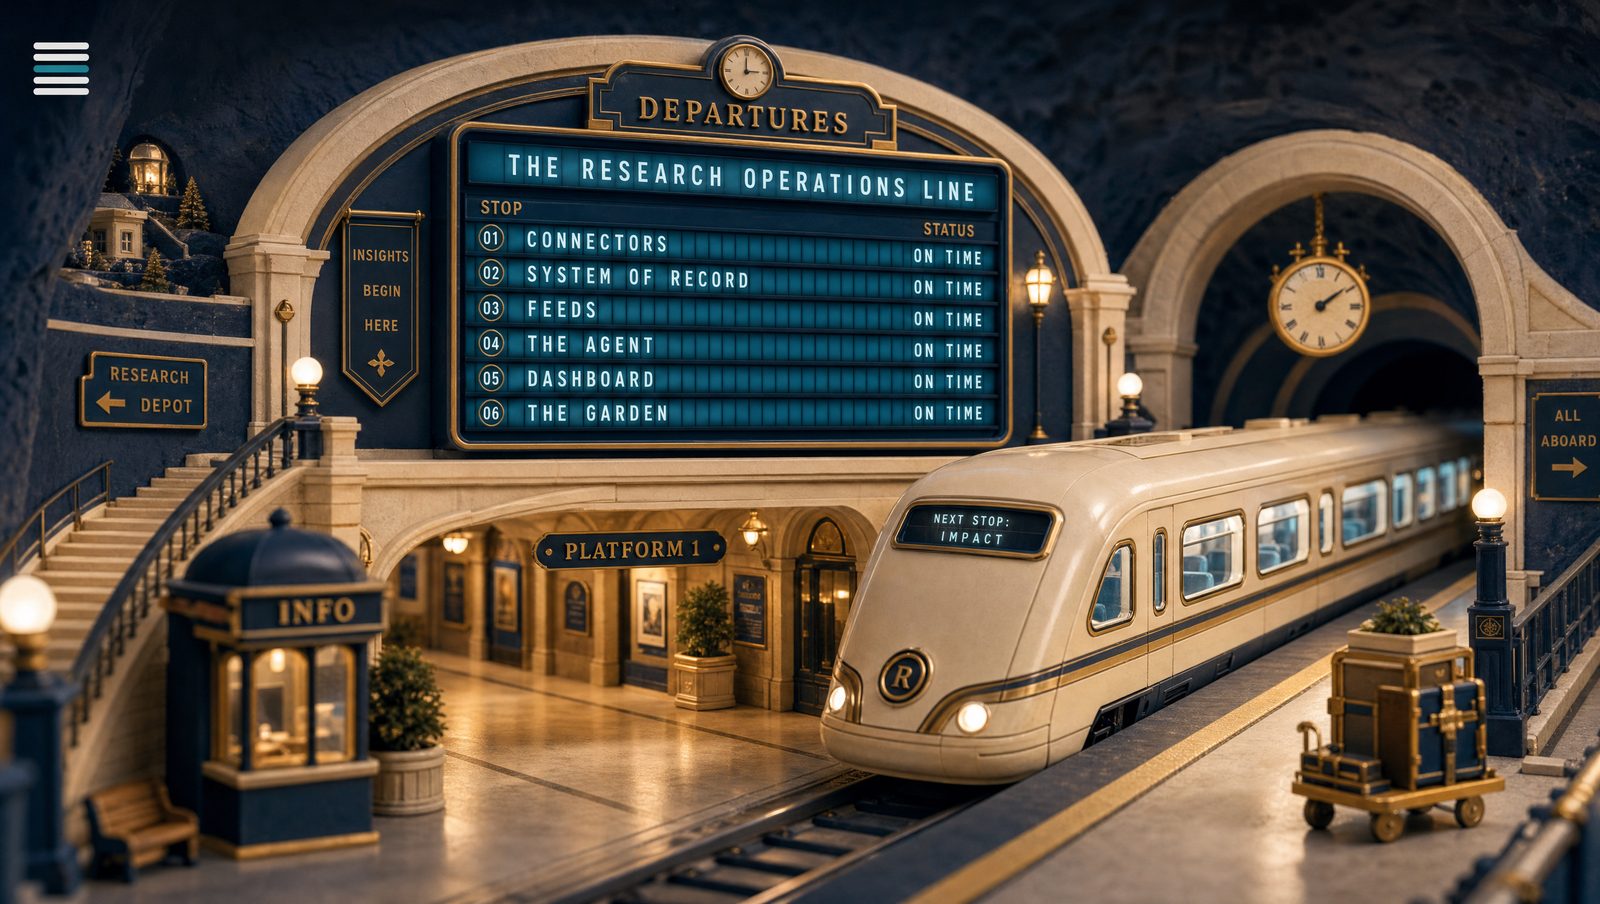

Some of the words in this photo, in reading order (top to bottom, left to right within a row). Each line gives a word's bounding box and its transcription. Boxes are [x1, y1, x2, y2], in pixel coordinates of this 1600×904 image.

[638, 95, 849, 135] DEPARTURES
[508, 153, 558, 179] THE
[582, 158, 722, 188] RESEARCH
[744, 167, 906, 198] OPERATIONS
[924, 179, 974, 202] LINE
[480, 200, 522, 214] STOP
[924, 222, 975, 238] STATUS
[353, 248, 409, 262] INSIGHTS
[483, 230, 499, 245] 01
[527, 230, 667, 252] CONNECTORS
[914, 248, 934, 264] ON
[946, 250, 982, 266] TIME
[483, 266, 500, 280] 02
[527, 265, 611, 284] SYSTEM
[629, 268, 652, 285] OF
[671, 269, 748, 288] RECORD
[914, 280, 934, 295] ON
[946, 280, 982, 296] TIME
[363, 284, 400, 298] BEGIN
[483, 301, 500, 316] 03
[528, 300, 596, 318] FEEDS
[914, 312, 934, 326] ON
[946, 312, 982, 328] TIME
[364, 318, 399, 332] HERE
[483, 336, 500, 350] 04
[528, 335, 567, 352] THE
[586, 336, 653, 354] AGENT
[914, 343, 934, 358] ON
[946, 344, 982, 358] TIME
[110, 366, 189, 384] RESEARCH
[483, 371, 500, 386] 05
[528, 370, 654, 388] DASHBOARD
[914, 374, 934, 389] ON
[946, 374, 982, 390] TIME
[141, 398, 192, 414] DEPOT
[483, 406, 500, 420] 06
[528, 404, 567, 422] THE
[586, 404, 668, 422] GARDEN
[914, 406, 934, 420] ON
[946, 406, 982, 420] TIME
[1555, 410, 1581, 422] ALL
[1541, 434, 1596, 447] ABOARD
[934, 514, 964, 525] NEXT
[972, 515, 1010, 527] STOP:
[941, 531, 1003, 545] IMPACT
[565, 540, 683, 560] PLATFORM
[692, 540, 700, 556] 1
[278, 597, 356, 625] INFO
[891, 665, 912, 689] R
